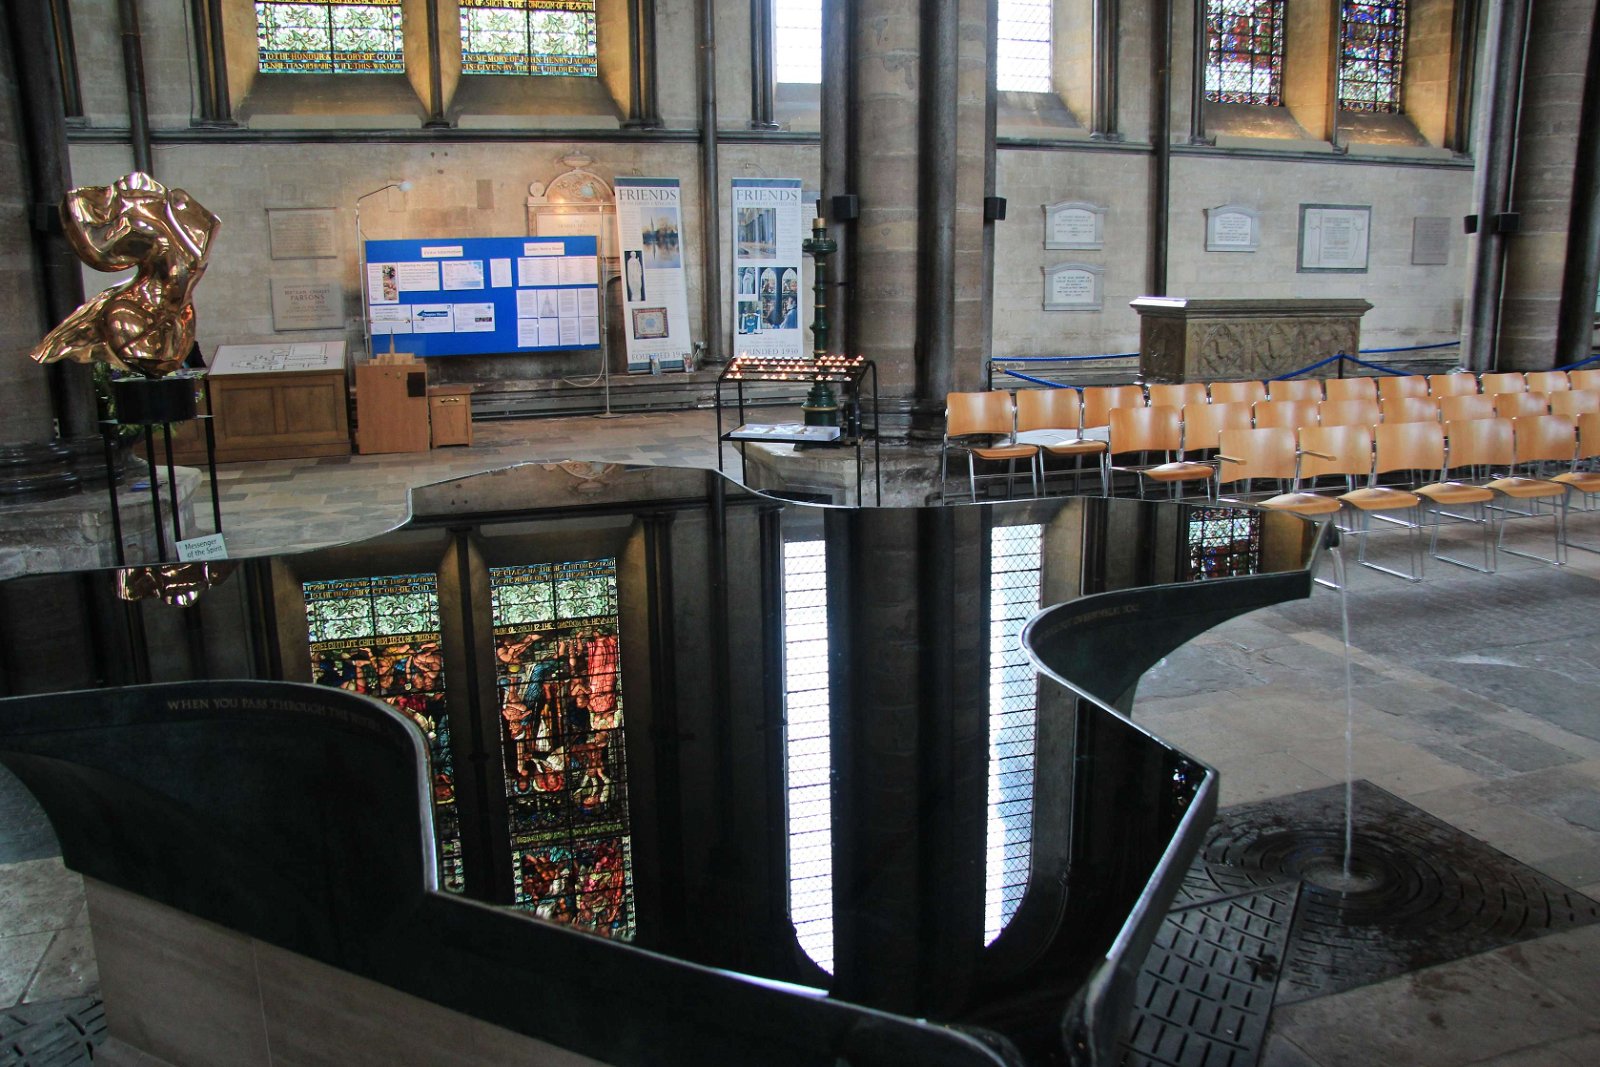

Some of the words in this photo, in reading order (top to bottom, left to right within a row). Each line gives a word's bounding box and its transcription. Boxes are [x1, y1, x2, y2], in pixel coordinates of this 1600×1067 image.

[520, 56, 541, 64] JOHN
[619, 189, 677, 201] FRIENDS
[736, 189, 798, 201] FRIENDS
[631, 352, 671, 360] FOUDED
[184, 540, 217, 550] Messenger
[206, 545, 223, 555] Spirit
[167, 698, 210, 712] WHEN
[213, 698, 239, 709] YOU
[242, 698, 269, 710] PASS
[269, 700, 325, 716] THROUGH
